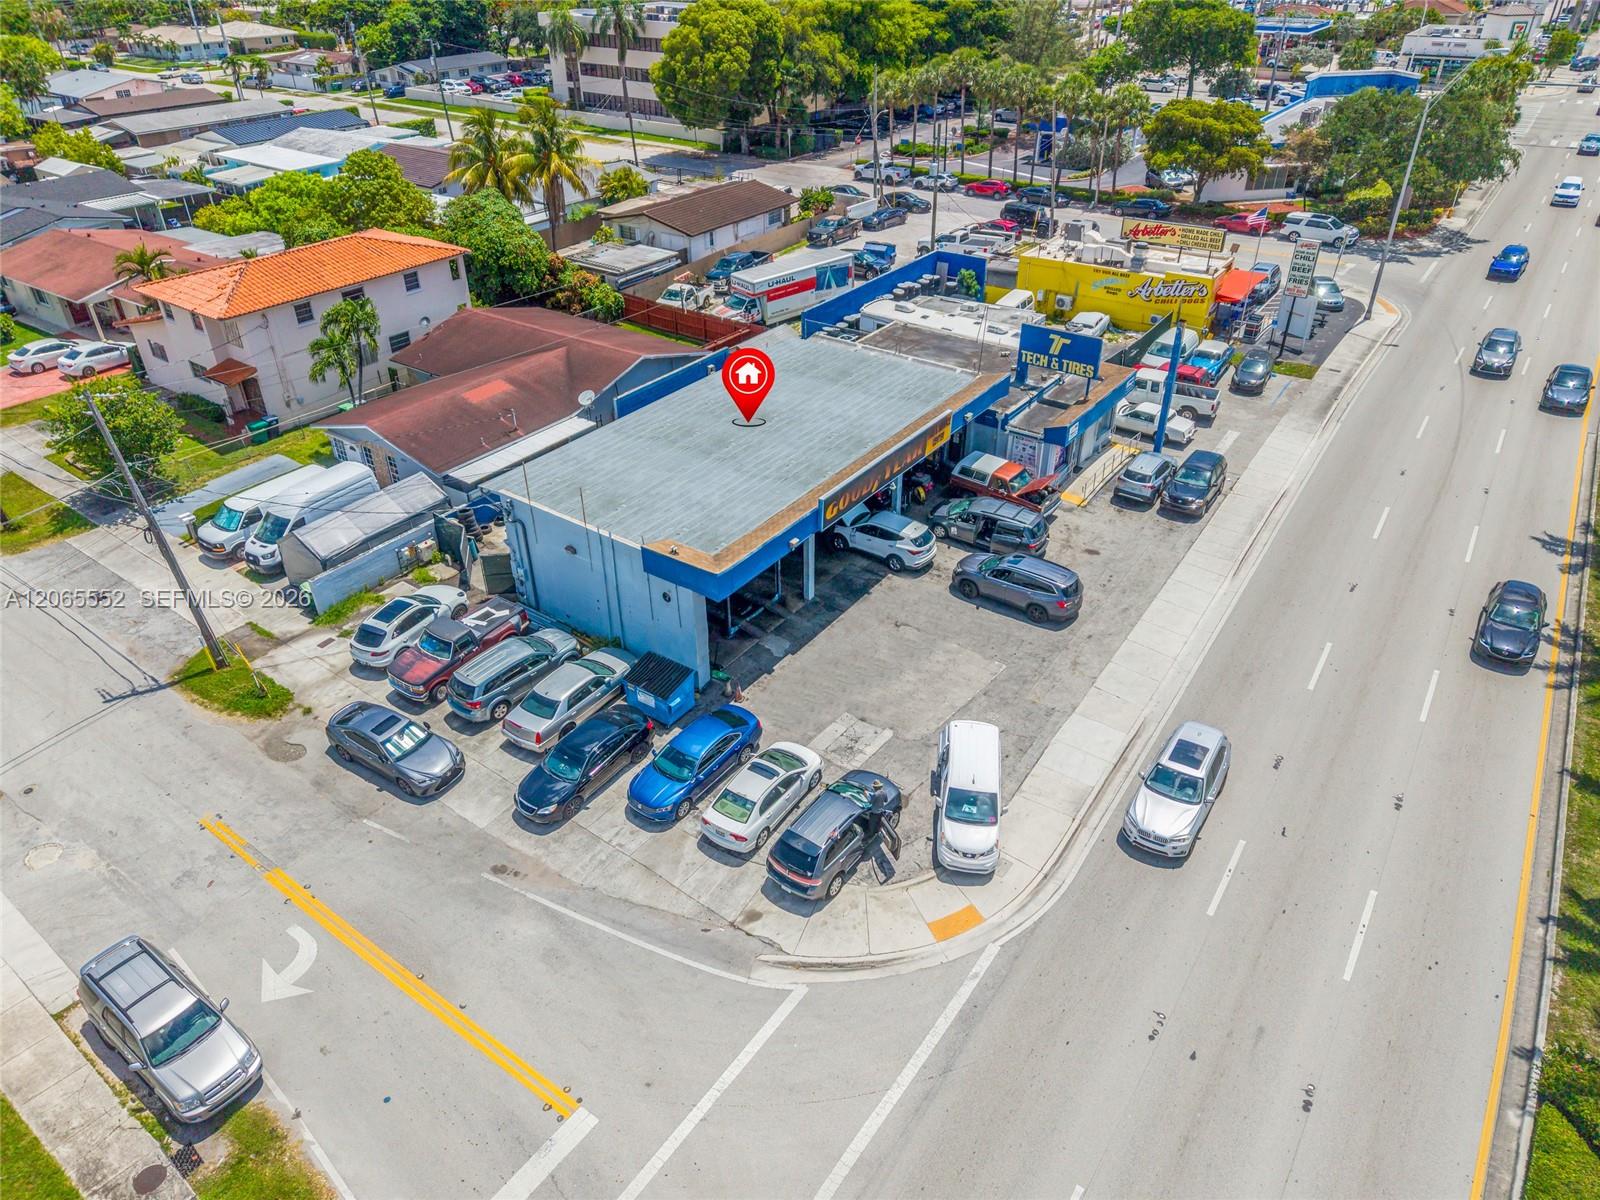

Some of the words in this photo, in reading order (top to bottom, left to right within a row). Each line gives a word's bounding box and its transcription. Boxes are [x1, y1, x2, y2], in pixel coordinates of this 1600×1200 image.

[1124, 223, 1176, 239] Arbetter's
[1294, 254, 1315, 262] CHILI
[1291, 265, 1312, 273] BEEF
[768, 276, 796, 288] U-HAUL
[1288, 277, 1309, 286] FRIES
[1128, 277, 1208, 302] Arbetter's
[1021, 350, 1048, 367] TECH
[1050, 357, 1059, 370] &
[1062, 360, 1094, 378] TIRES
